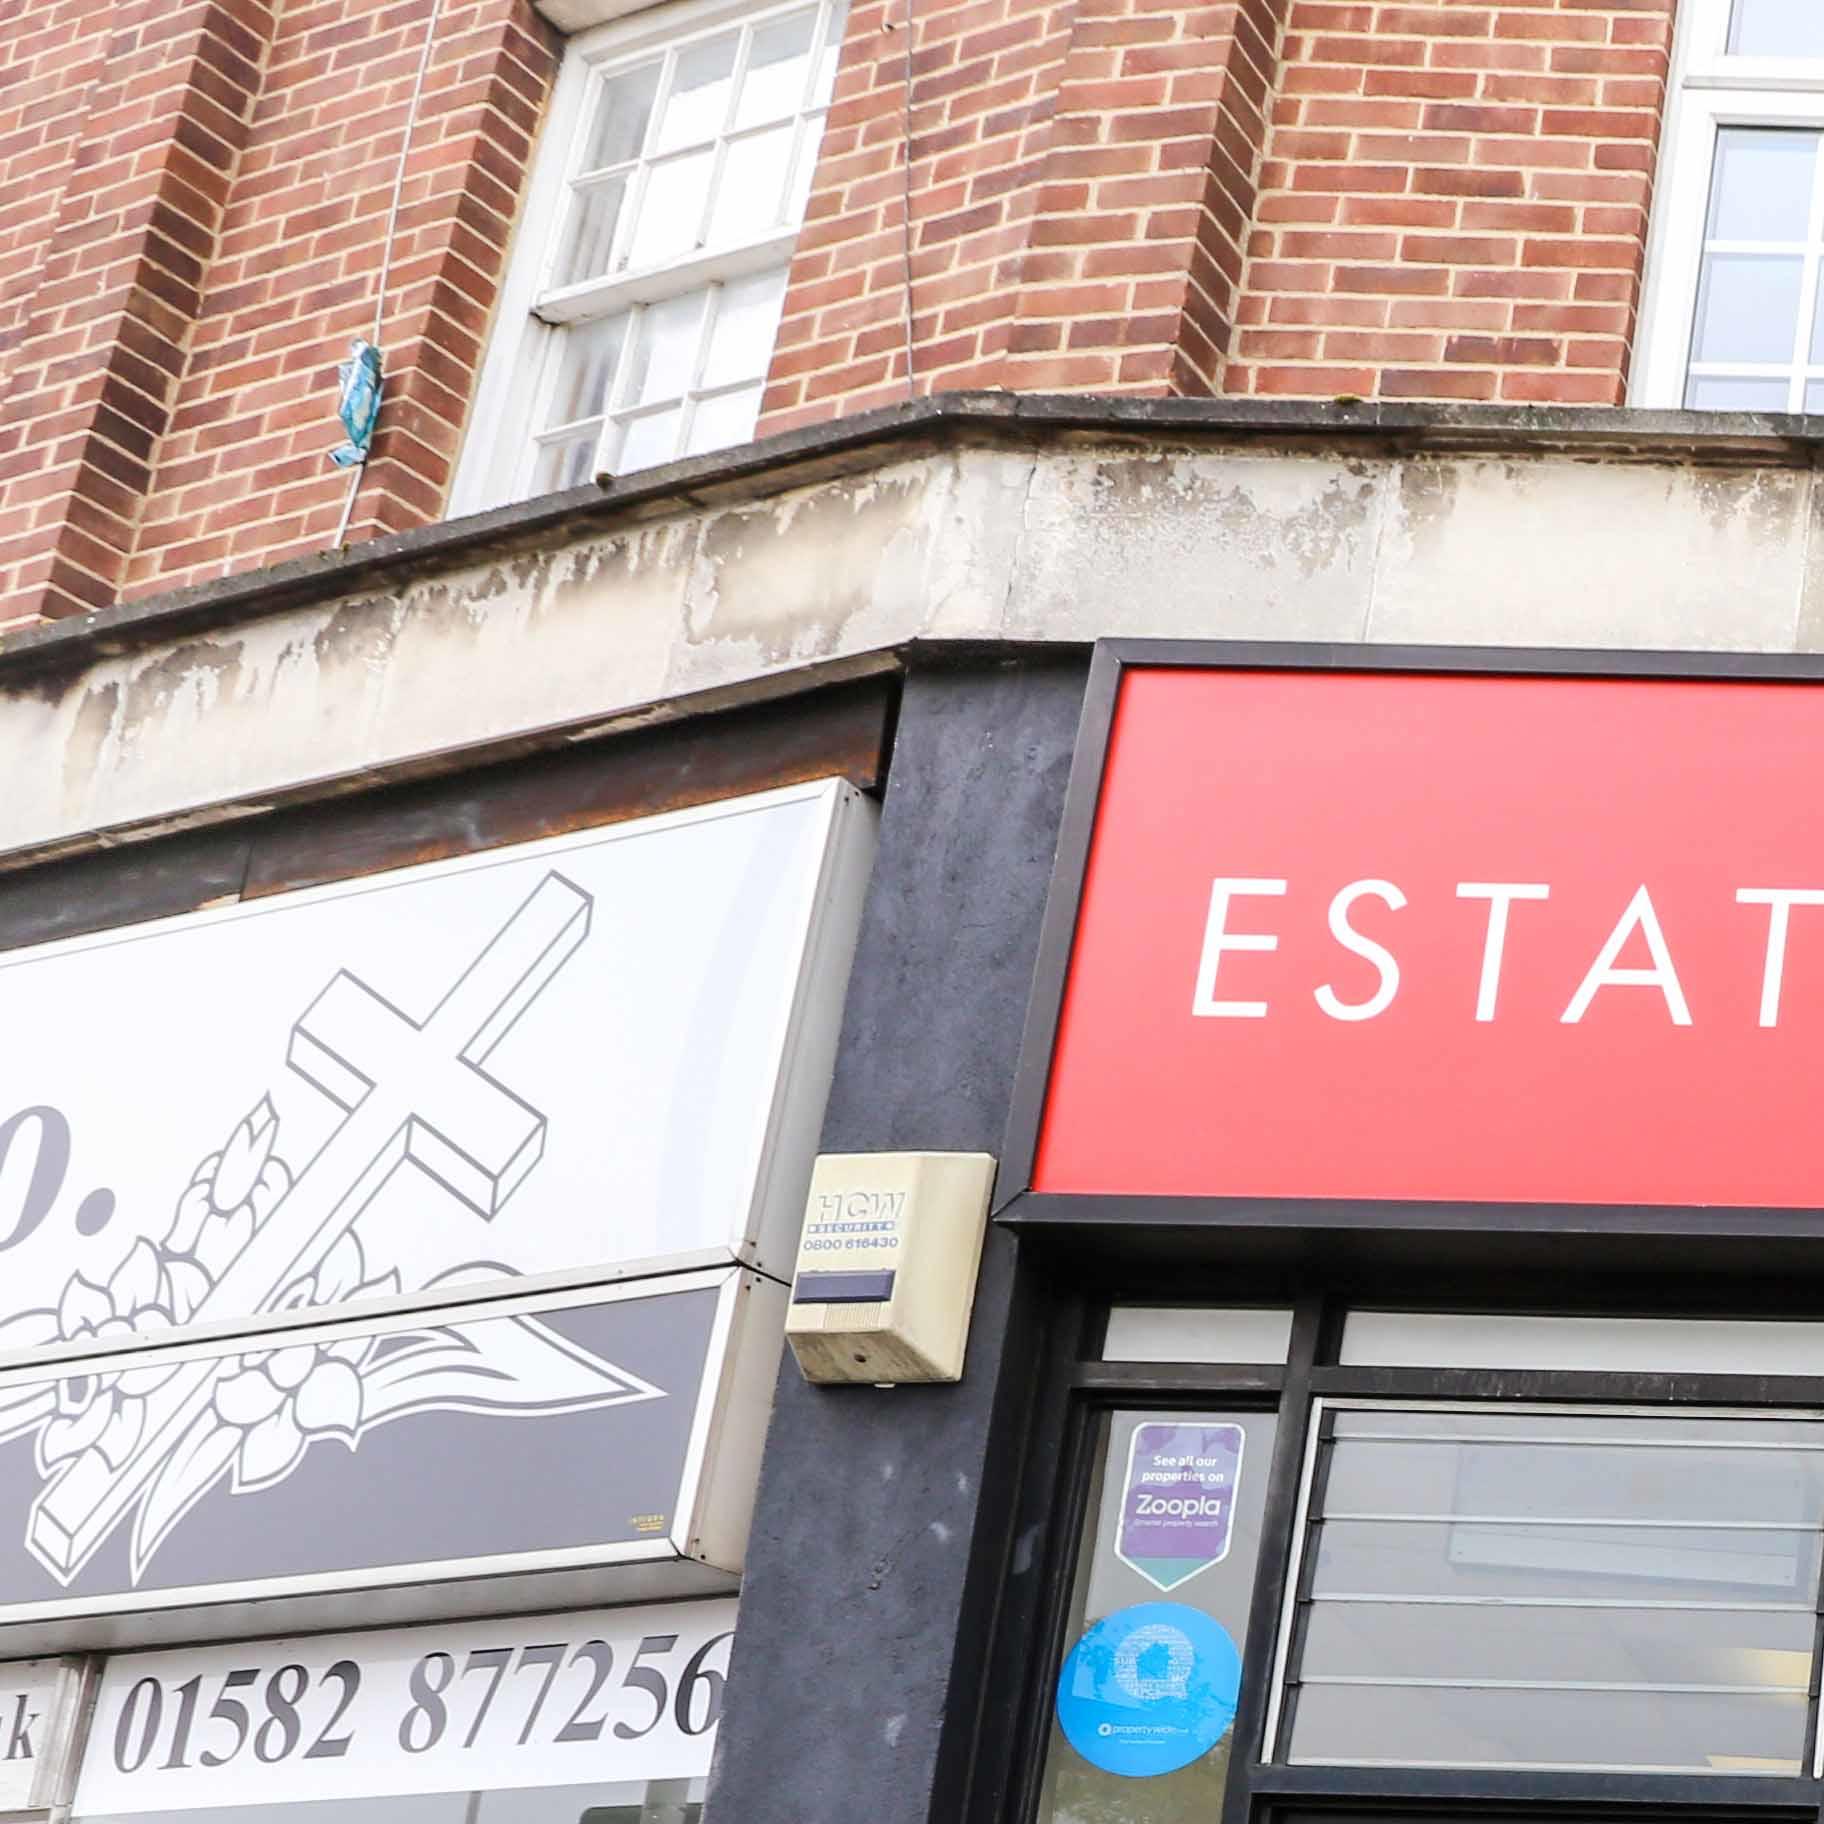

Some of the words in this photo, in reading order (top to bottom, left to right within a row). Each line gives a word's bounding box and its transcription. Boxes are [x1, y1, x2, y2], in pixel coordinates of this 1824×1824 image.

[803, 1238, 842, 1250] 0800
[845, 1237, 899, 1249] 616430
[1153, 1455, 1176, 1466] See
[1178, 1455, 1193, 1466] all
[1196, 1457, 1217, 1466] our
[1141, 1470, 1203, 1483] properties
[1208, 1473, 1224, 1482] on
[1136, 1494, 1221, 1520] Zoopla
[114, 1659, 362, 1774] 01582
[399, 1630, 736, 1755] 877256
